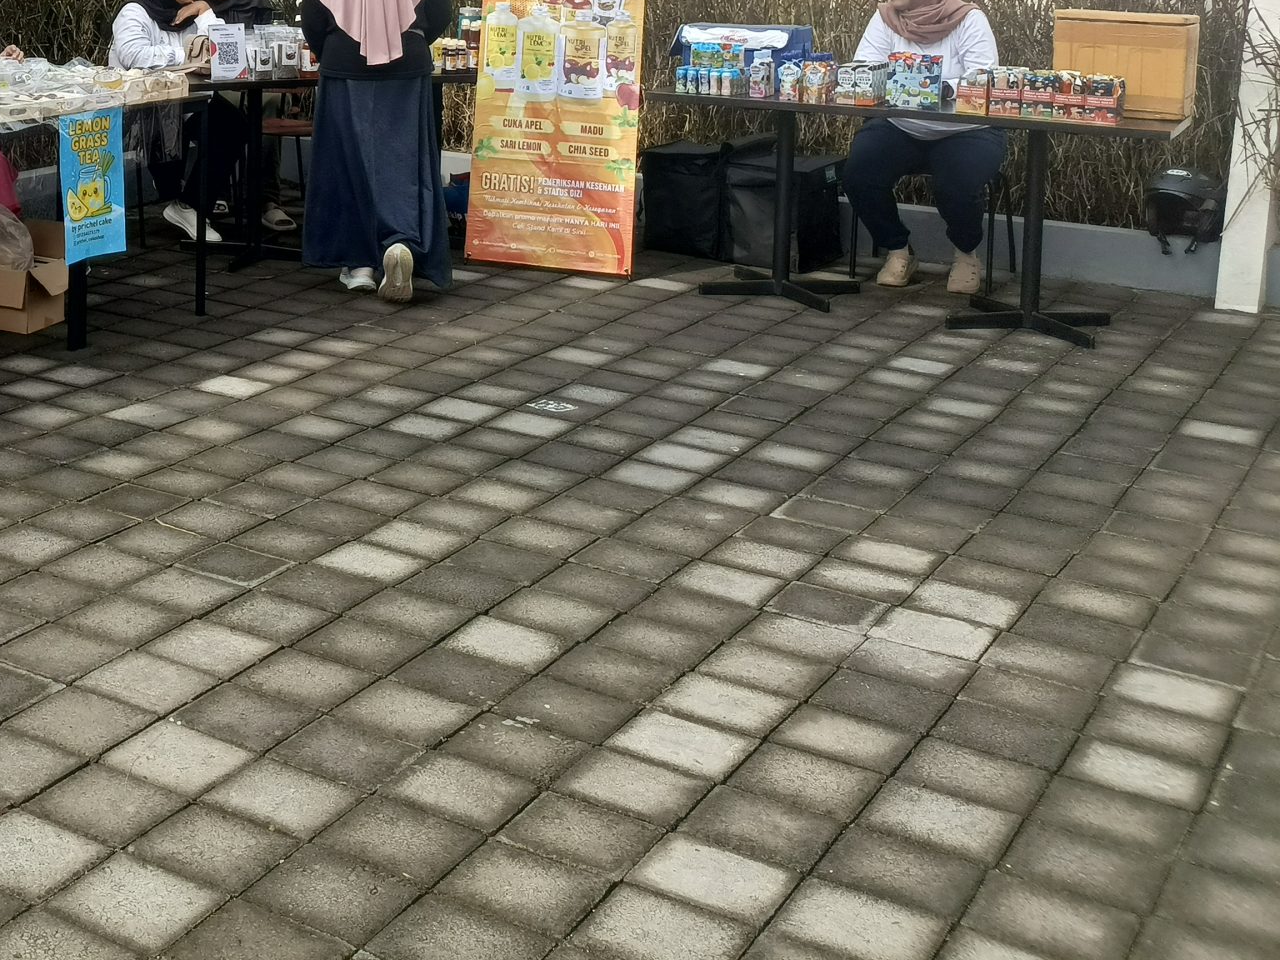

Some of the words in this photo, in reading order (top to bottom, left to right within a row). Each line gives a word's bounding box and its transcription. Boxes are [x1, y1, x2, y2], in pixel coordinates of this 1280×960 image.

[69, 116, 111, 136] LEMON
[502, 118, 523, 129] CUKA
[524, 120, 543, 130] APEL
[580, 125, 604, 136] MADU
[71, 131, 109, 152] GRASS
[500, 139, 516, 150] SARI
[517, 141, 542, 152] LEMON
[78, 149, 100, 164] TEA
[568, 144, 587, 155] CHIA
[589, 146, 609, 157] SEED
[481, 171, 535, 194] GRATIS!
[537, 177, 585, 189] PEMERIKSAAN
[585, 181, 625, 193] KESEHATAN
[564, 218, 589, 226] HANYA
